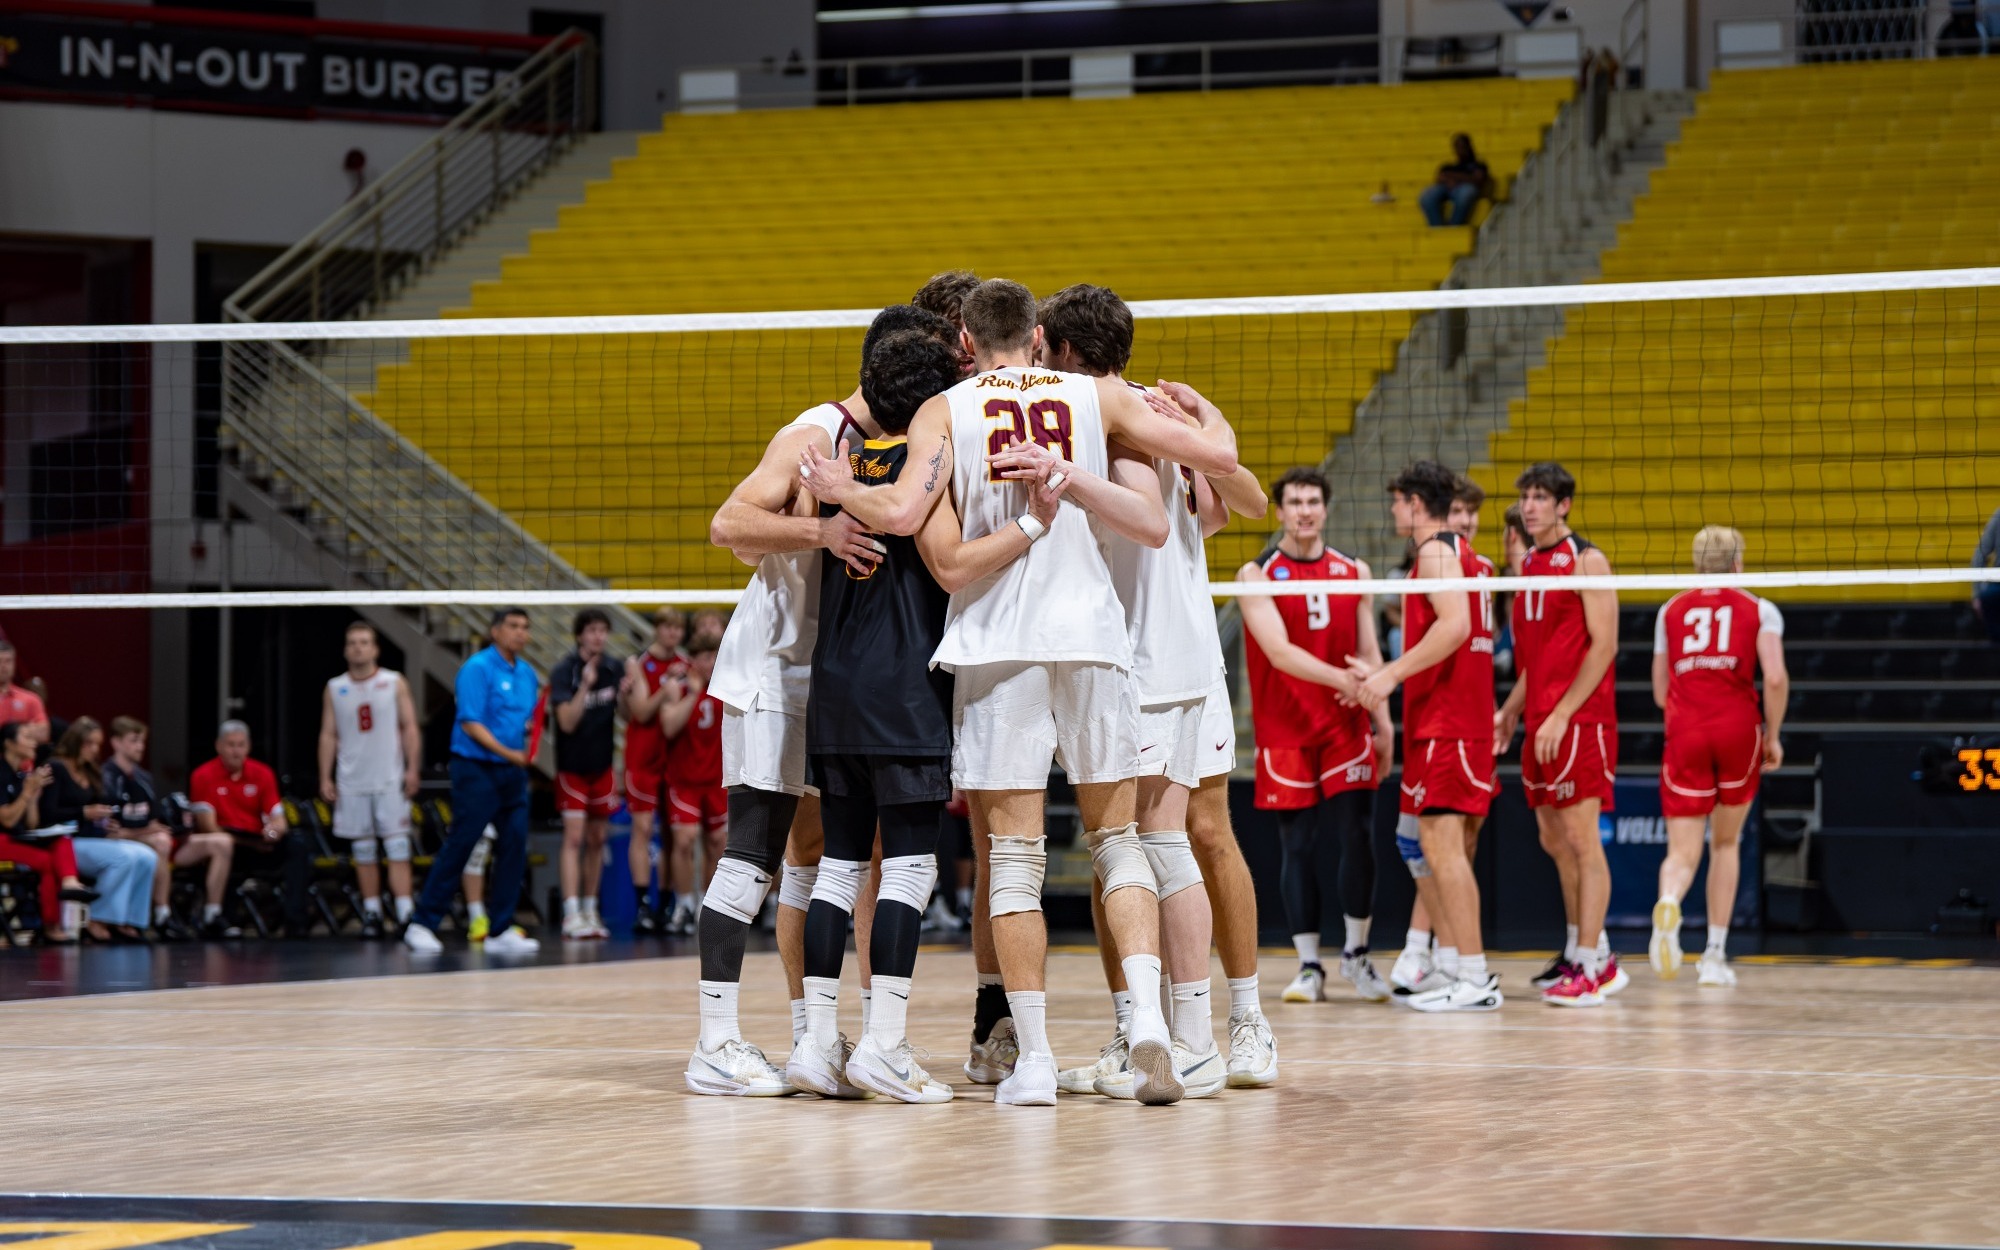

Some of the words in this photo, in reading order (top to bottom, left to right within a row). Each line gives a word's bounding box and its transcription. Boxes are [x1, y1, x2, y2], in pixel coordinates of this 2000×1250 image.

[60, 35, 306, 91] IN-N-OUT
[1305, 592, 1331, 631] 9
[1682, 605, 1733, 655] 31
[697, 698, 715, 730] 3
[1345, 764, 1373, 783] SFU
[1958, 749, 2000, 791] 33
